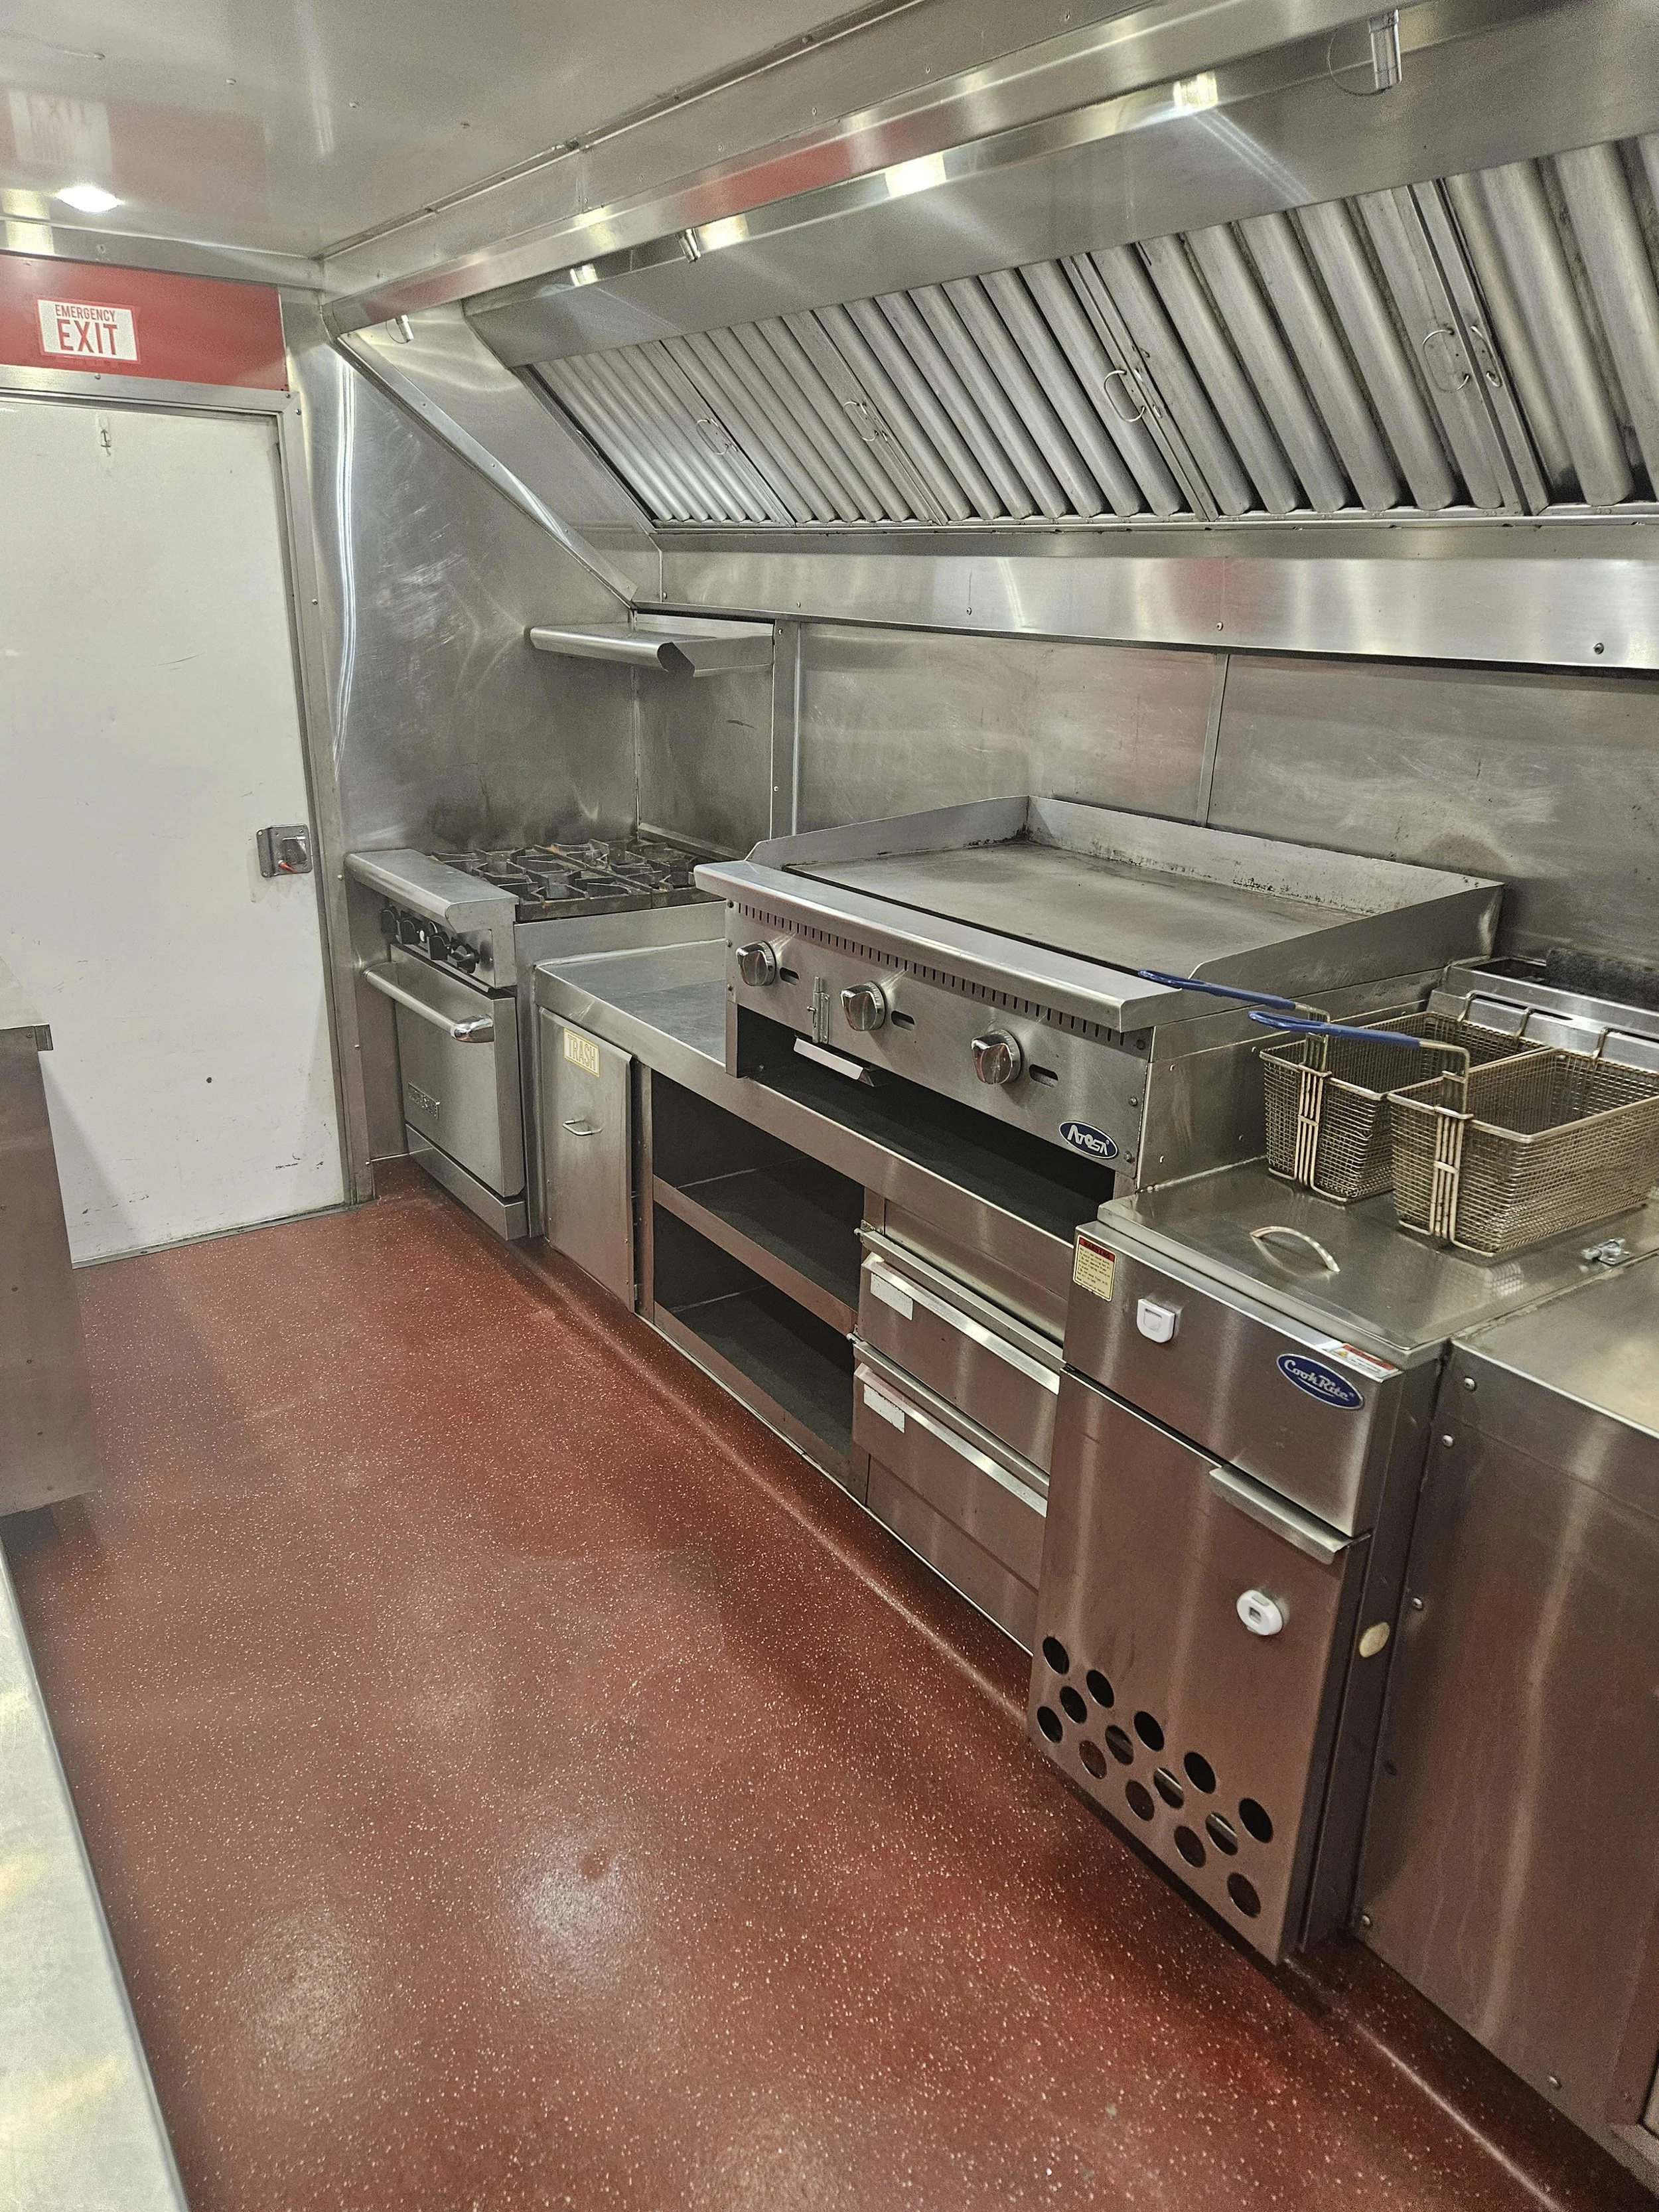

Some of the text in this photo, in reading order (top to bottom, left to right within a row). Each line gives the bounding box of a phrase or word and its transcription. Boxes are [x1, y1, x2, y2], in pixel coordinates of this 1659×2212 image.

[55, 305, 115, 322] EMERGENCY
[56, 319, 117, 356] EXIT
[567, 1034, 596, 1070] TRASH
